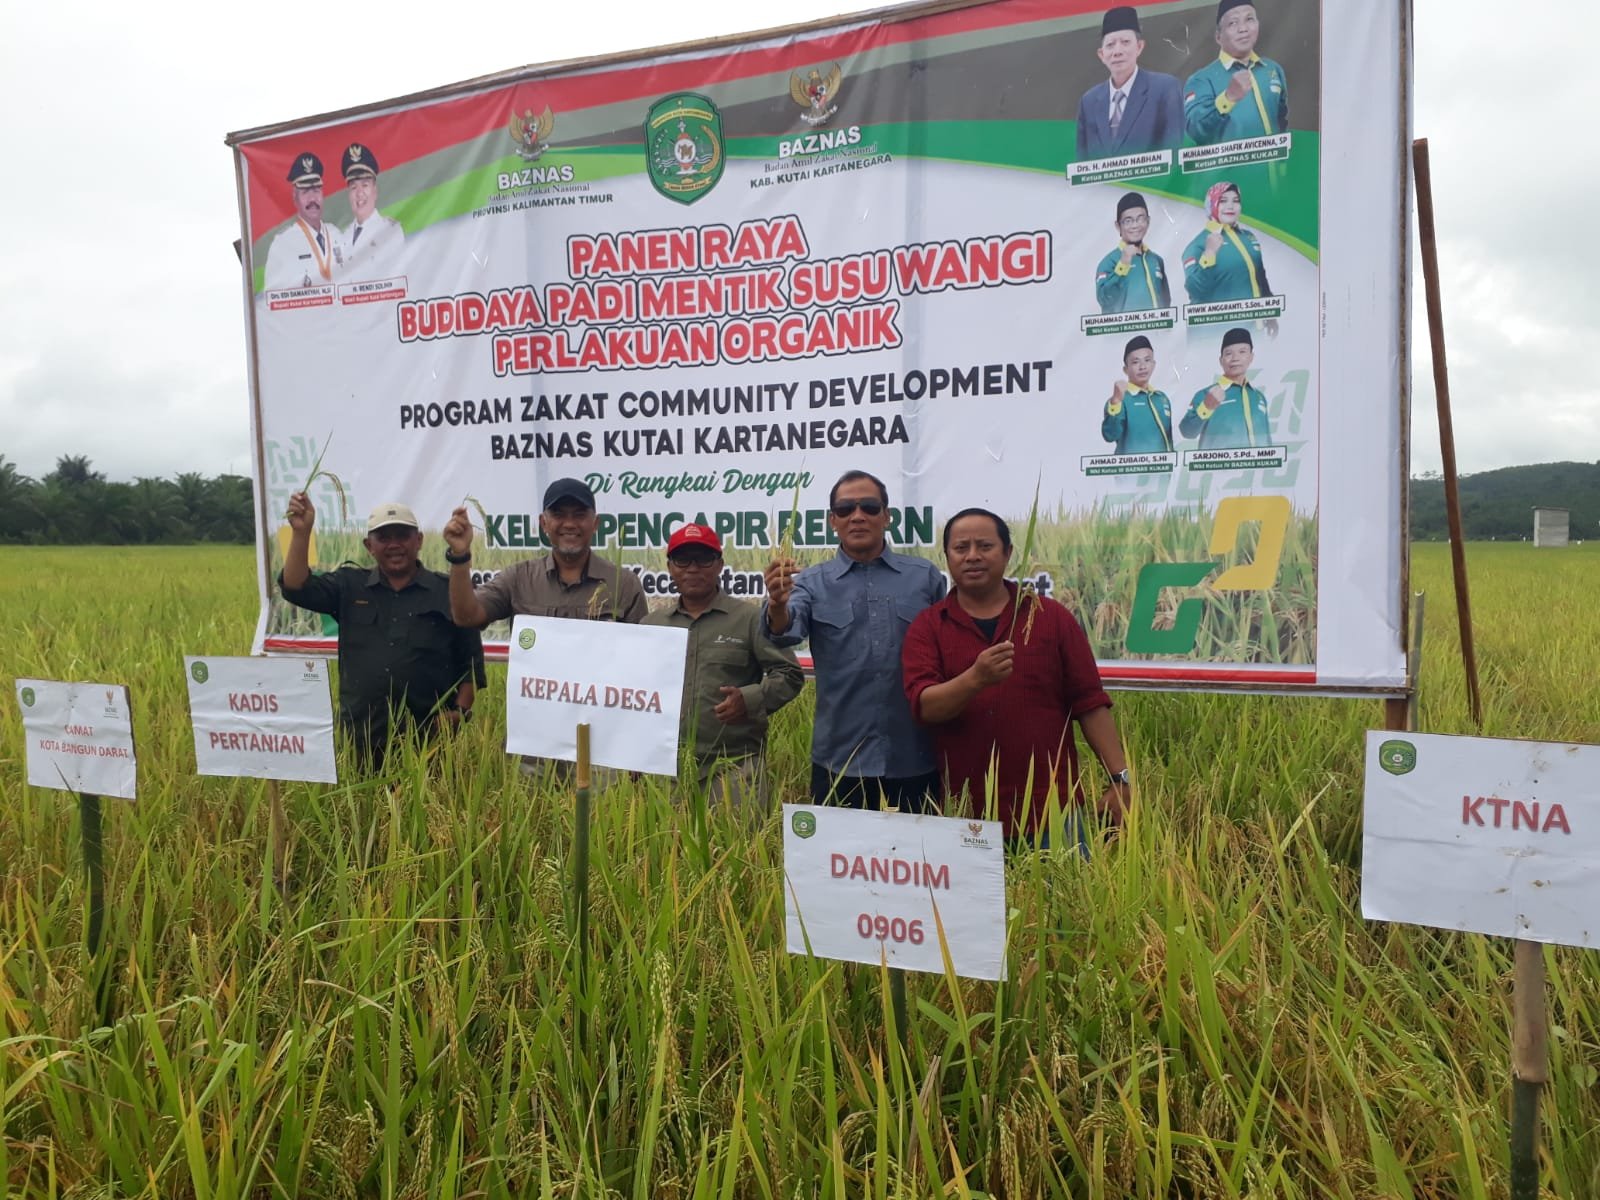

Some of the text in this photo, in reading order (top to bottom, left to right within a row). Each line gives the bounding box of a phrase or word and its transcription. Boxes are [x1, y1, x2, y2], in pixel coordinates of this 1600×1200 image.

[779, 126, 861, 158] BAZNAS
[1183, 148, 1220, 159] MUHAMMAD
[1220, 143, 1243, 153] SHAFIK
[750, 154, 892, 189] KAB. KUTAI KARTANEGARA
[1101, 159, 1129, 169] AHMAD
[1130, 154, 1162, 165] NABHAN
[1218, 155, 1249, 165] BAZNAS
[1251, 150, 1279, 160] KUKAR
[497, 165, 574, 190] BAZNAS
[1103, 170, 1133, 179] BAZNAS
[1134, 166, 1162, 174] KALTIM
[472, 193, 614, 219] PROVINSI KALIMANTAN TIMUR
[569, 218, 807, 278] PANEN RAYA
[399, 235, 1048, 340] BUDIDAYA PADI MENTIK SUSU WANGI
[1085, 315, 1123, 325] MUHAMMAD
[495, 304, 901, 374] PERLAKUAN ORGANIK
[400, 360, 1053, 430] PROGRAM ZAKAT COMMUNITY DEVELOPMENT
[491, 414, 910, 460] BAZNAS KUTAI KARTANEGARA
[1090, 457, 1117, 465] AHMAD
[584, 468, 815, 499] Di Rangkai Dengan
[228, 692, 279, 714] KADIS
[520, 676, 663, 714] KEPALA DESA
[64, 724, 94, 737] CAMAT
[209, 730, 305, 755] PERTANIAN
[40, 739, 129, 759] KOTA BANGUN DARAT
[1461, 794, 1572, 835] KTNA
[830, 852, 951, 891] DANDIM
[857, 912, 925, 946] 0906
